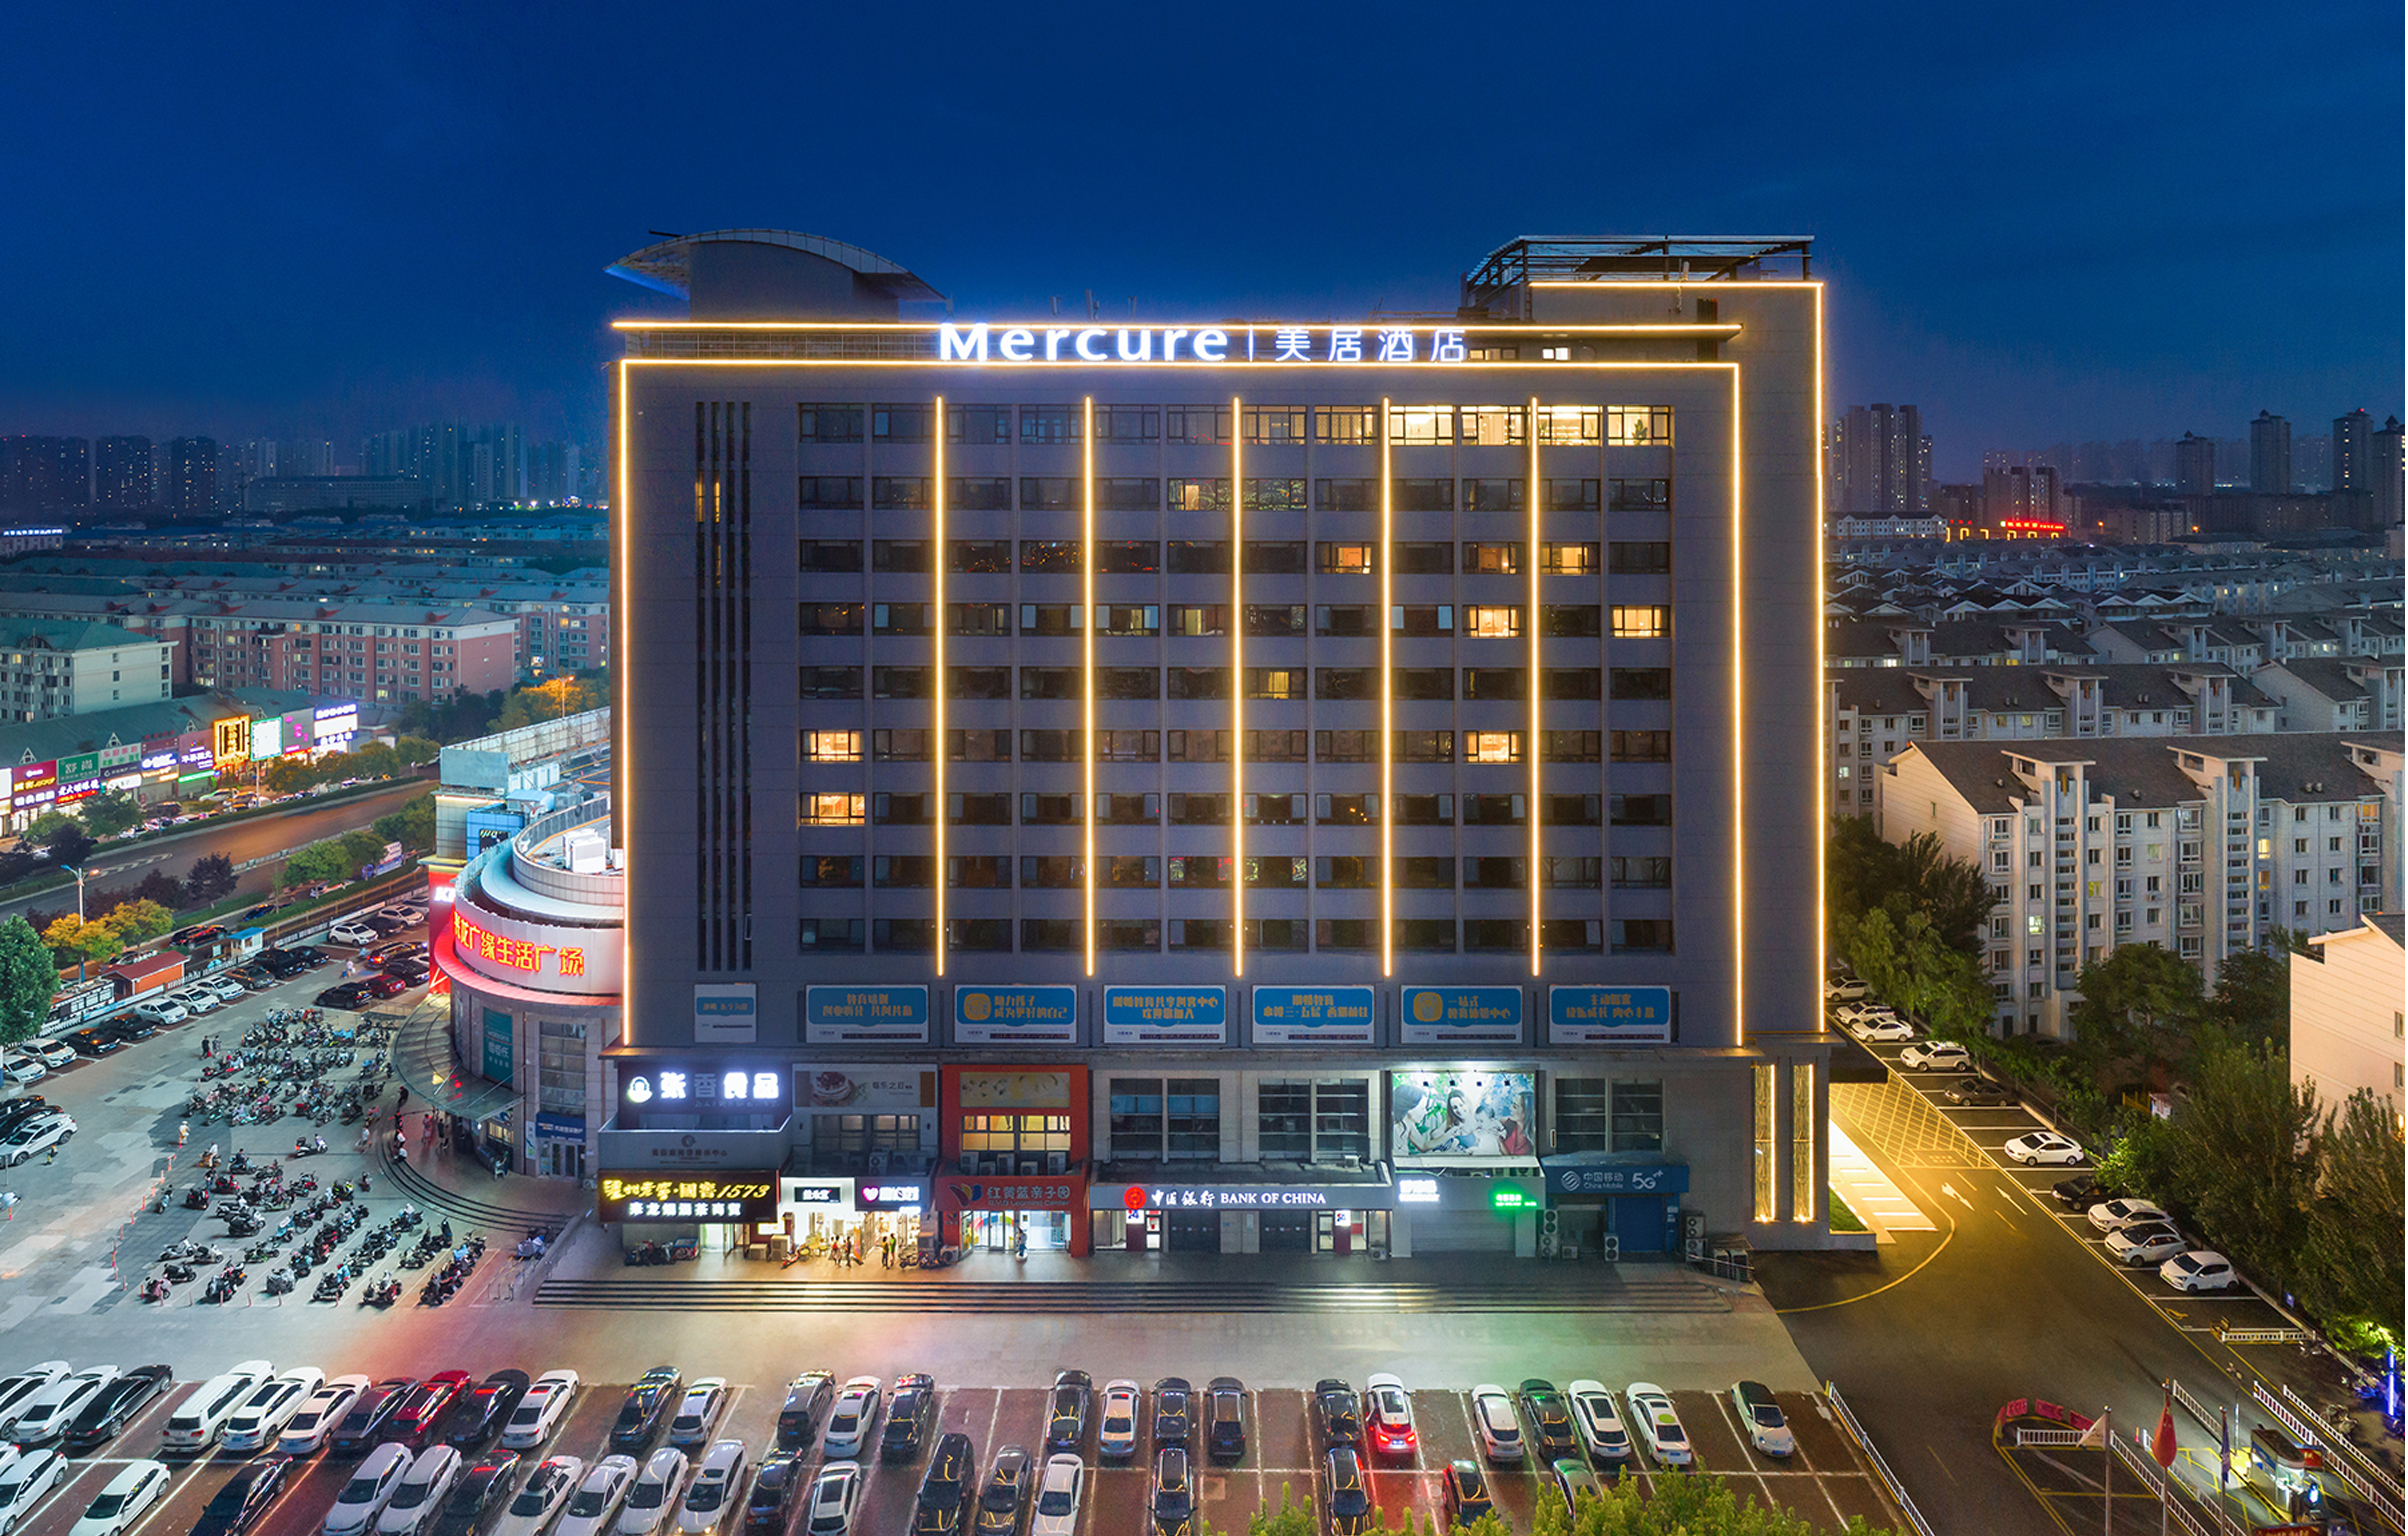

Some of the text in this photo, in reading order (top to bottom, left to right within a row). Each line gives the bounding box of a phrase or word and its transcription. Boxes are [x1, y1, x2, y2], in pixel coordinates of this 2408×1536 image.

[939, 323, 1228, 362] Mercure
[1274, 328, 1467, 363] 美居酒店
[994, 995, 1035, 1007] 助力孩子
[1448, 995, 1479, 1007] 一站式
[994, 1006, 1067, 1019] 成为更好的自己
[1142, 1007, 1194, 1019] 欢迎您加入
[1583, 1171, 1625, 1182] 中国移动
[987, 1185, 1070, 1199] 红黄蓝亲子园
[1151, 1189, 1216, 1207] 中国银行
[1010, 1199, 1043, 1207] Learning
[1220, 1193, 1327, 1204] BANK OF CHINA
